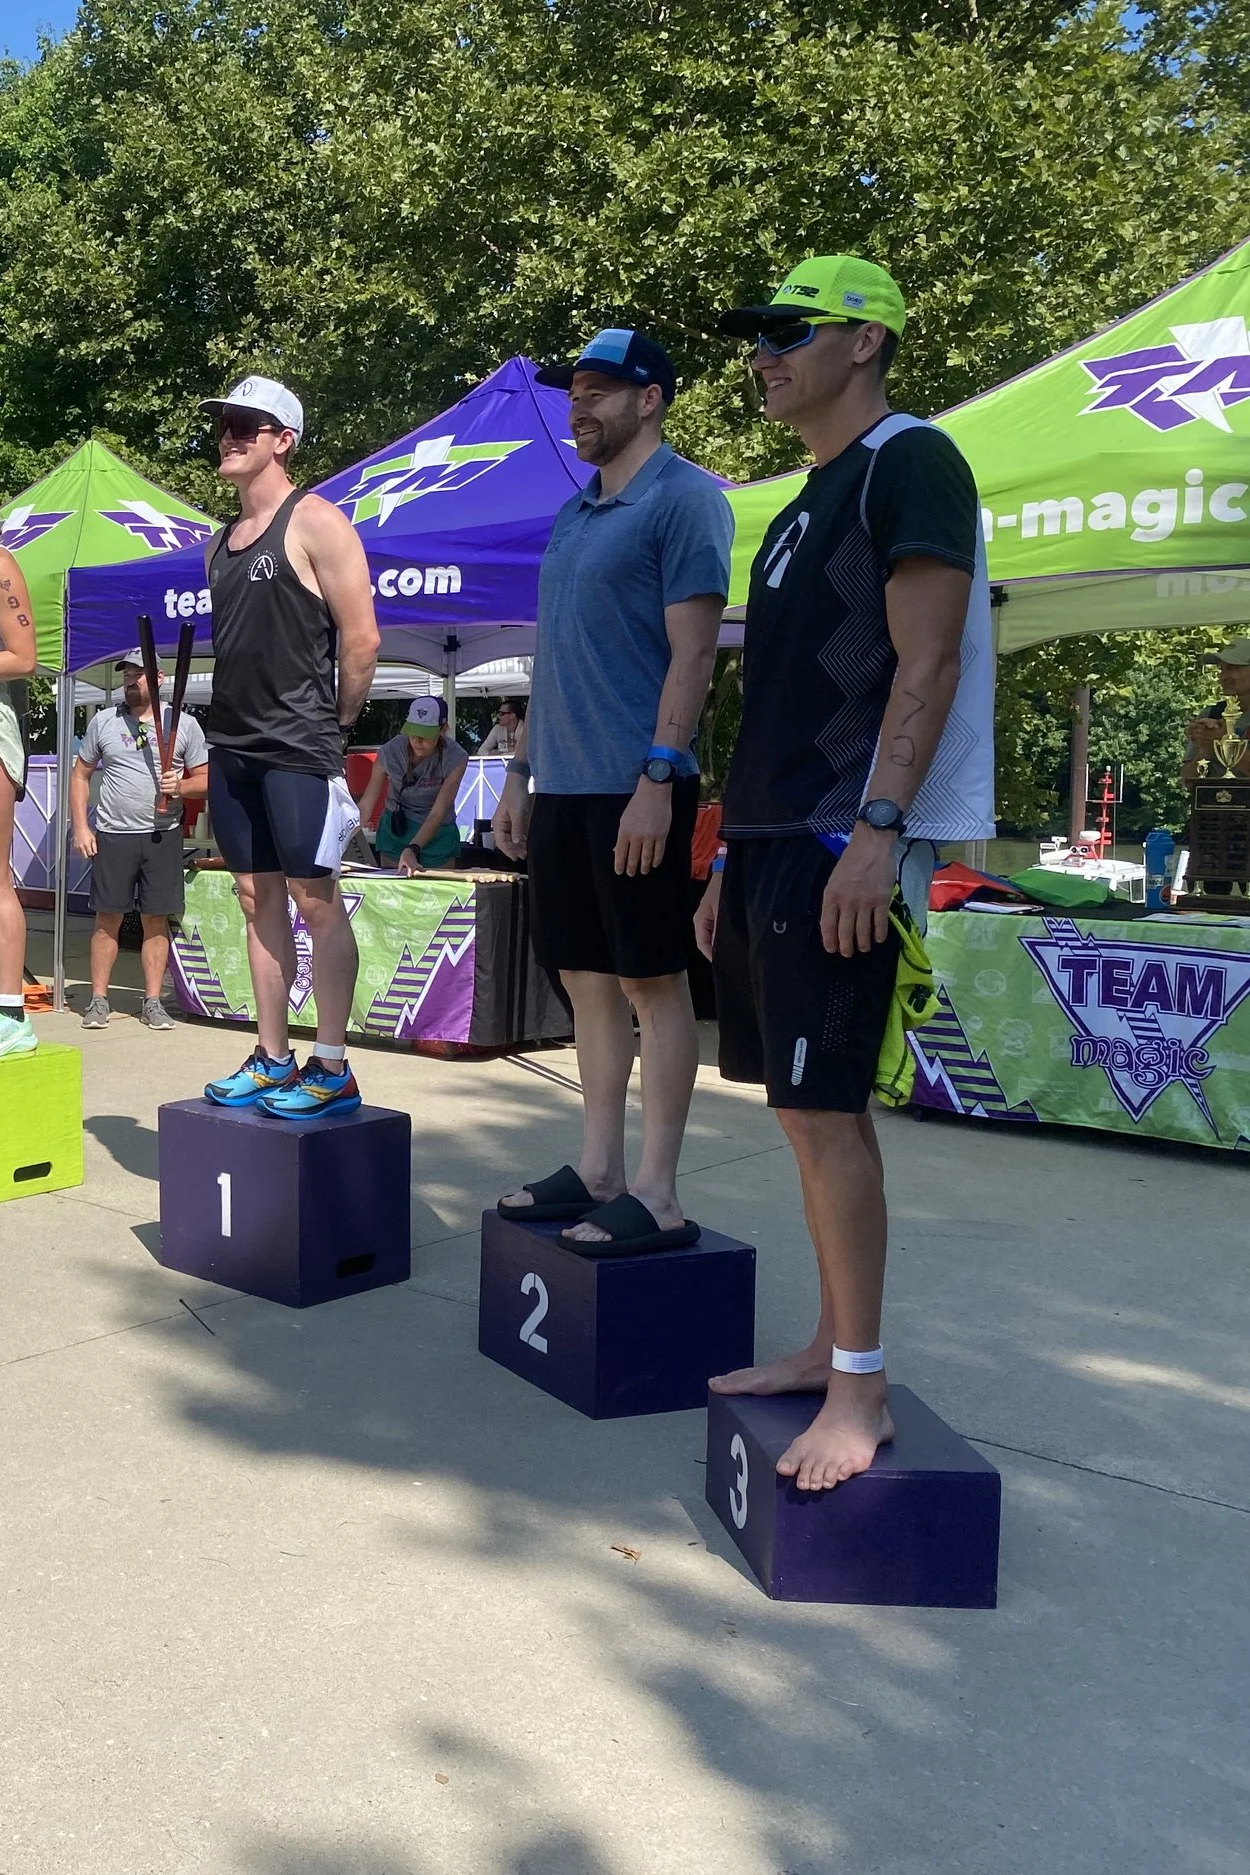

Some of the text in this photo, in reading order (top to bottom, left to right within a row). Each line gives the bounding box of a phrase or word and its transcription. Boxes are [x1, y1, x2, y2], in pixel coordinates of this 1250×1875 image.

[1058, 955, 1228, 1022] TEAM
[1070, 1035, 1218, 1090] magic
[217, 1172, 231, 1237] 1
[519, 1272, 549, 1354] 2
[729, 1433, 748, 1529] 3
